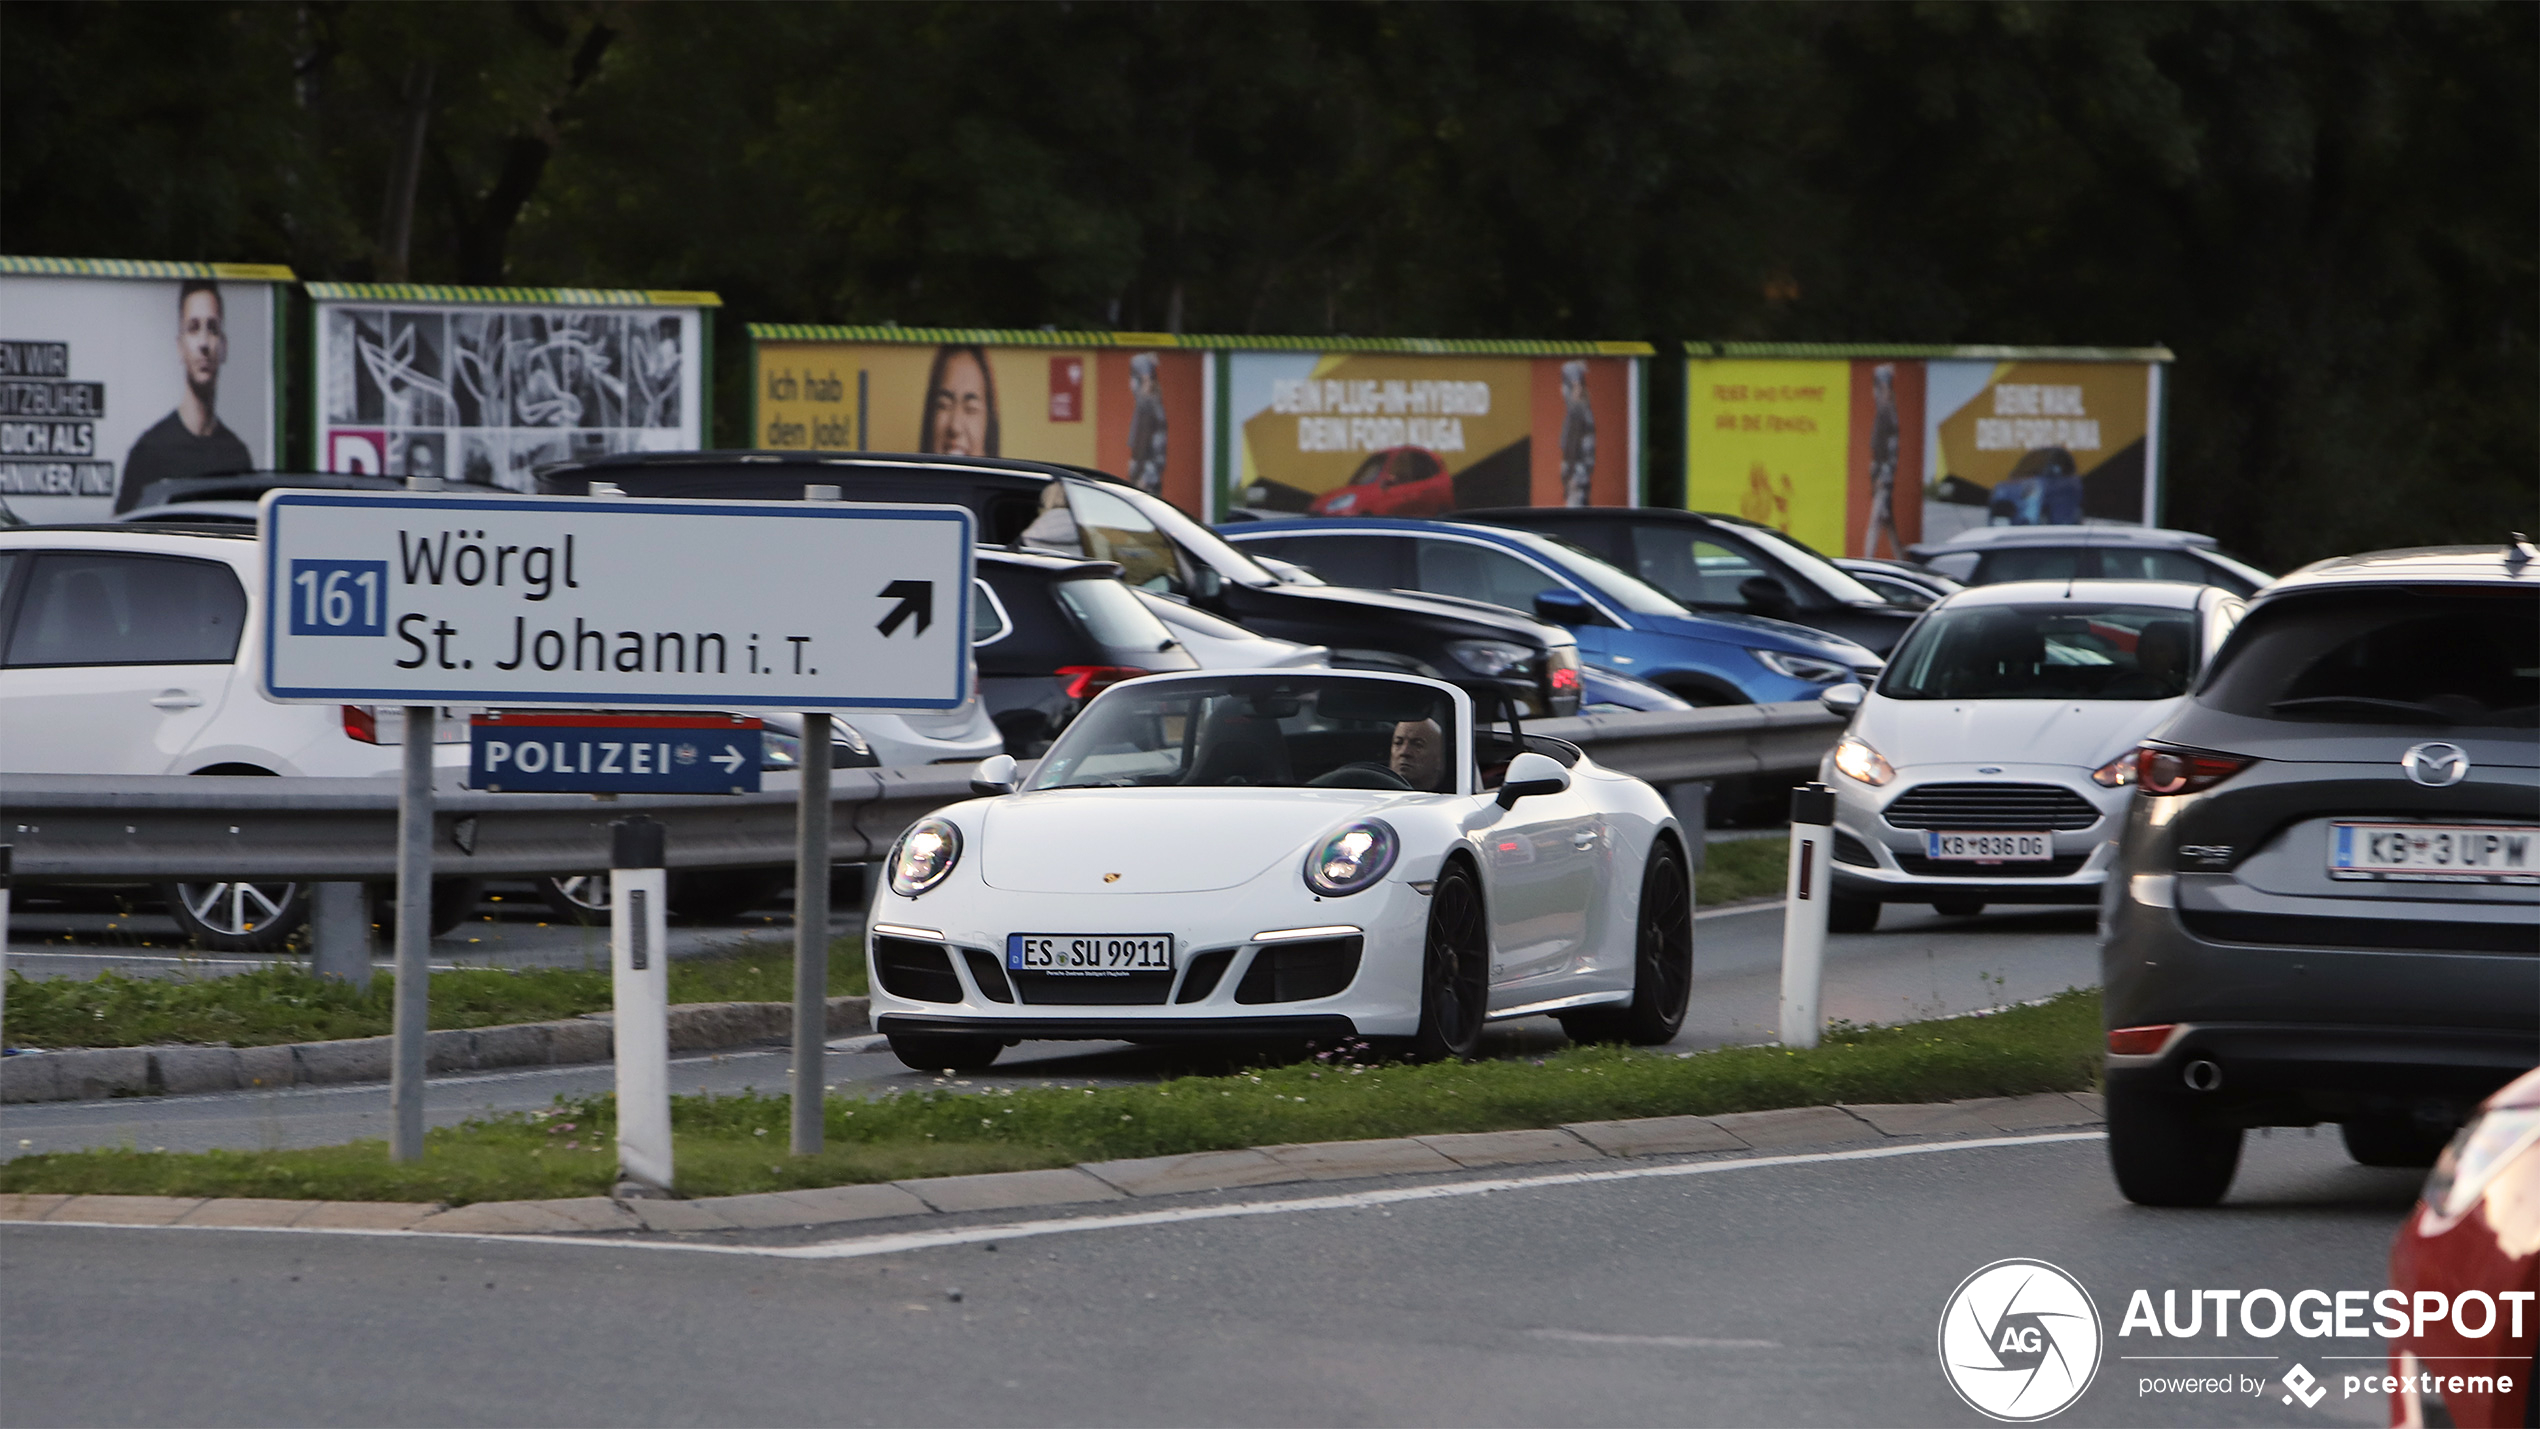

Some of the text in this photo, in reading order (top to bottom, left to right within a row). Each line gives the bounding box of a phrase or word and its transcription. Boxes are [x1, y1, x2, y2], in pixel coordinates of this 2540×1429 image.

[23, 344, 64, 376] WIR
[768, 369, 843, 403] Ich hab
[1272, 378, 1491, 416] DEIN PLUG-IN-HYBRID
[1, 422, 92, 455] DICH ALS
[767, 412, 806, 447] den
[1298, 416, 1348, 452] DEIN
[1351, 416, 1405, 451] FORD
[398, 529, 578, 601] Wörgl
[294, 569, 378, 626] 161
[394, 612, 818, 676] St. Johann i. T.
[485, 741, 670, 775] POLIZEI
[1942, 836, 1965, 855] KB
[1979, 837, 2015, 855] 836
[2369, 832, 2408, 864] KB
[1024, 940, 1167, 966] ES SU 9911
